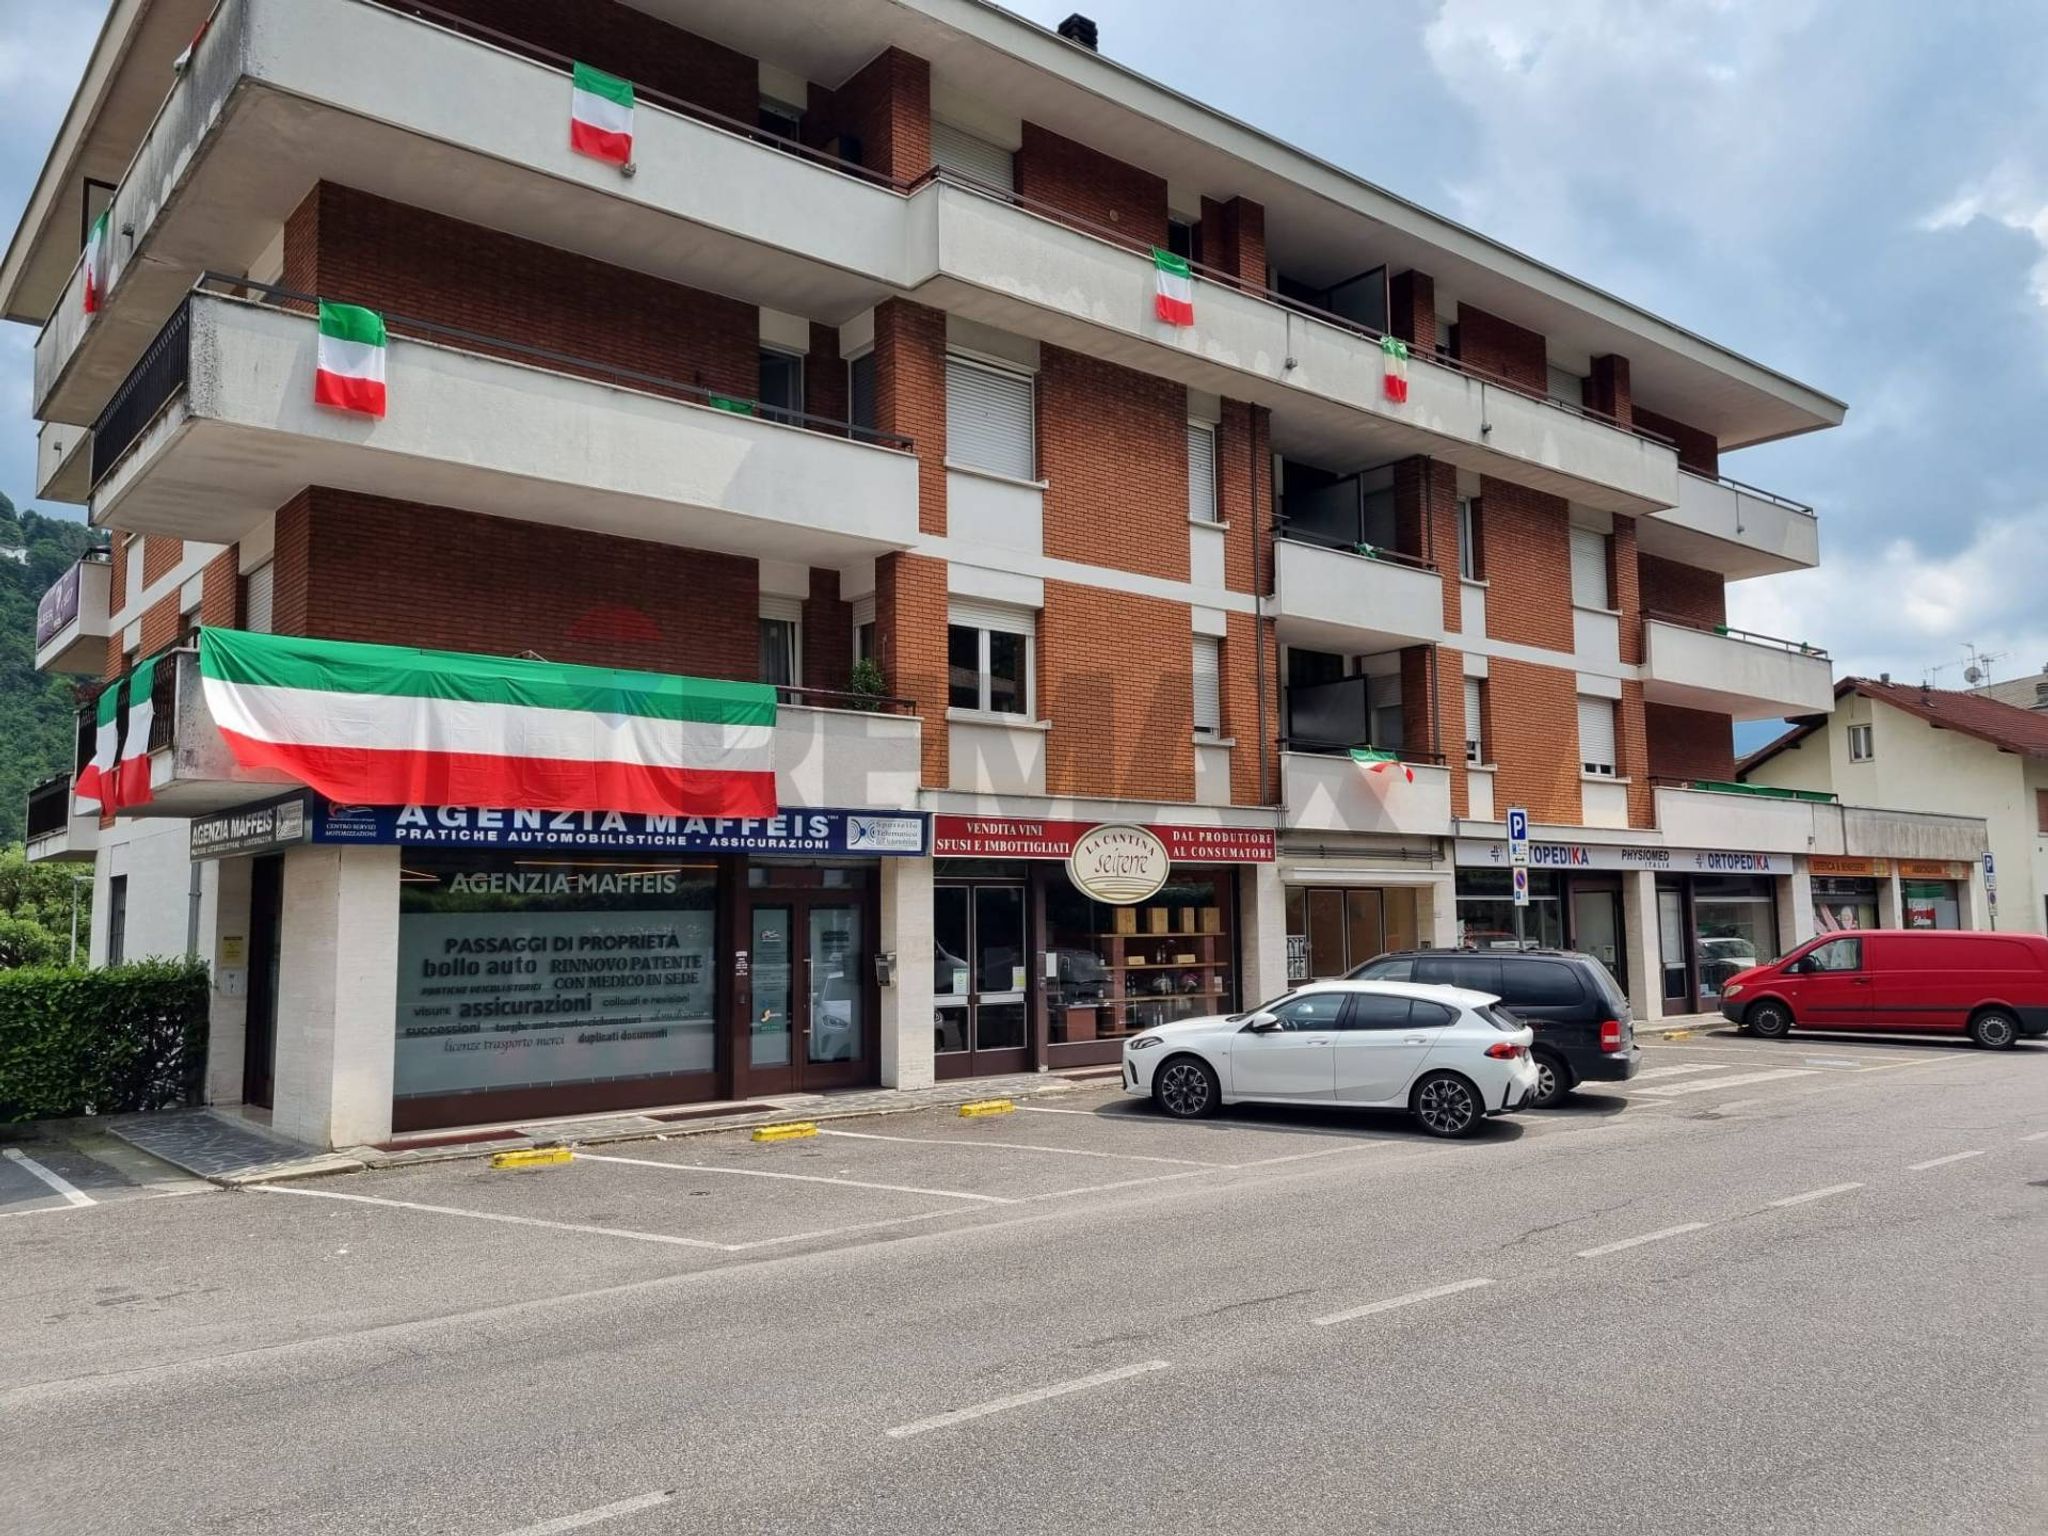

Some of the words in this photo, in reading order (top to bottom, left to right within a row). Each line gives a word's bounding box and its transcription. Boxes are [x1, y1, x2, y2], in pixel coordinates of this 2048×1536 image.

[192, 818, 229, 847] AGENZIA
[230, 808, 273, 839] MAFFEIS
[396, 804, 628, 833] AGENZIA
[645, 811, 830, 839] MAFFEIS
[967, 823, 1016, 836] VENDITA
[1018, 824, 1043, 837] VINI
[1513, 815, 1523, 838] P
[396, 828, 498, 842] PRATICHE
[507, 831, 687, 846] AUTOMOBILISTICHE
[709, 837, 830, 849] ASSICURAZIONI
[936, 838, 972, 851] SFUSI
[974, 839, 982, 851] E
[984, 840, 1070, 854] IMBOTTIGLIATI
[1085, 839, 1101, 856] LA
[1103, 833, 1154, 856] CANTINA
[1173, 831, 1195, 843] DAL
[1198, 831, 1273, 845] PRODUTTORE
[1173, 845, 1188, 857] AL
[1191, 846, 1274, 859] CONSUMATORE
[1528, 846, 1590, 865] TOPEDIKA
[1621, 848, 1670, 862] PHYSIOMED
[1644, 861, 1670, 869] ITALIA
[1707, 853, 1770, 871] ORTOPEDIKA
[448, 872, 571, 894] AGENZIA
[577, 873, 677, 894] MAFFEIS
[445, 936, 547, 954] PASSAGGI
[553, 936, 573, 951] DI
[423, 957, 480, 978] bollo
[486, 956, 537, 975] auto
[550, 957, 628, 973] RINNOVO
[630, 954, 703, 971] PATENTE
[554, 976, 585, 990] CON
[587, 974, 645, 989] MEDICO
[646, 973, 662, 986] IN
[665, 972, 699, 985] SEDE
[459, 992, 592, 1019] assicurazioni
[405, 1021, 481, 1037] successioni
[577, 1031, 619, 1045] duplicati
[483, 1037, 533, 1051] trasporto
